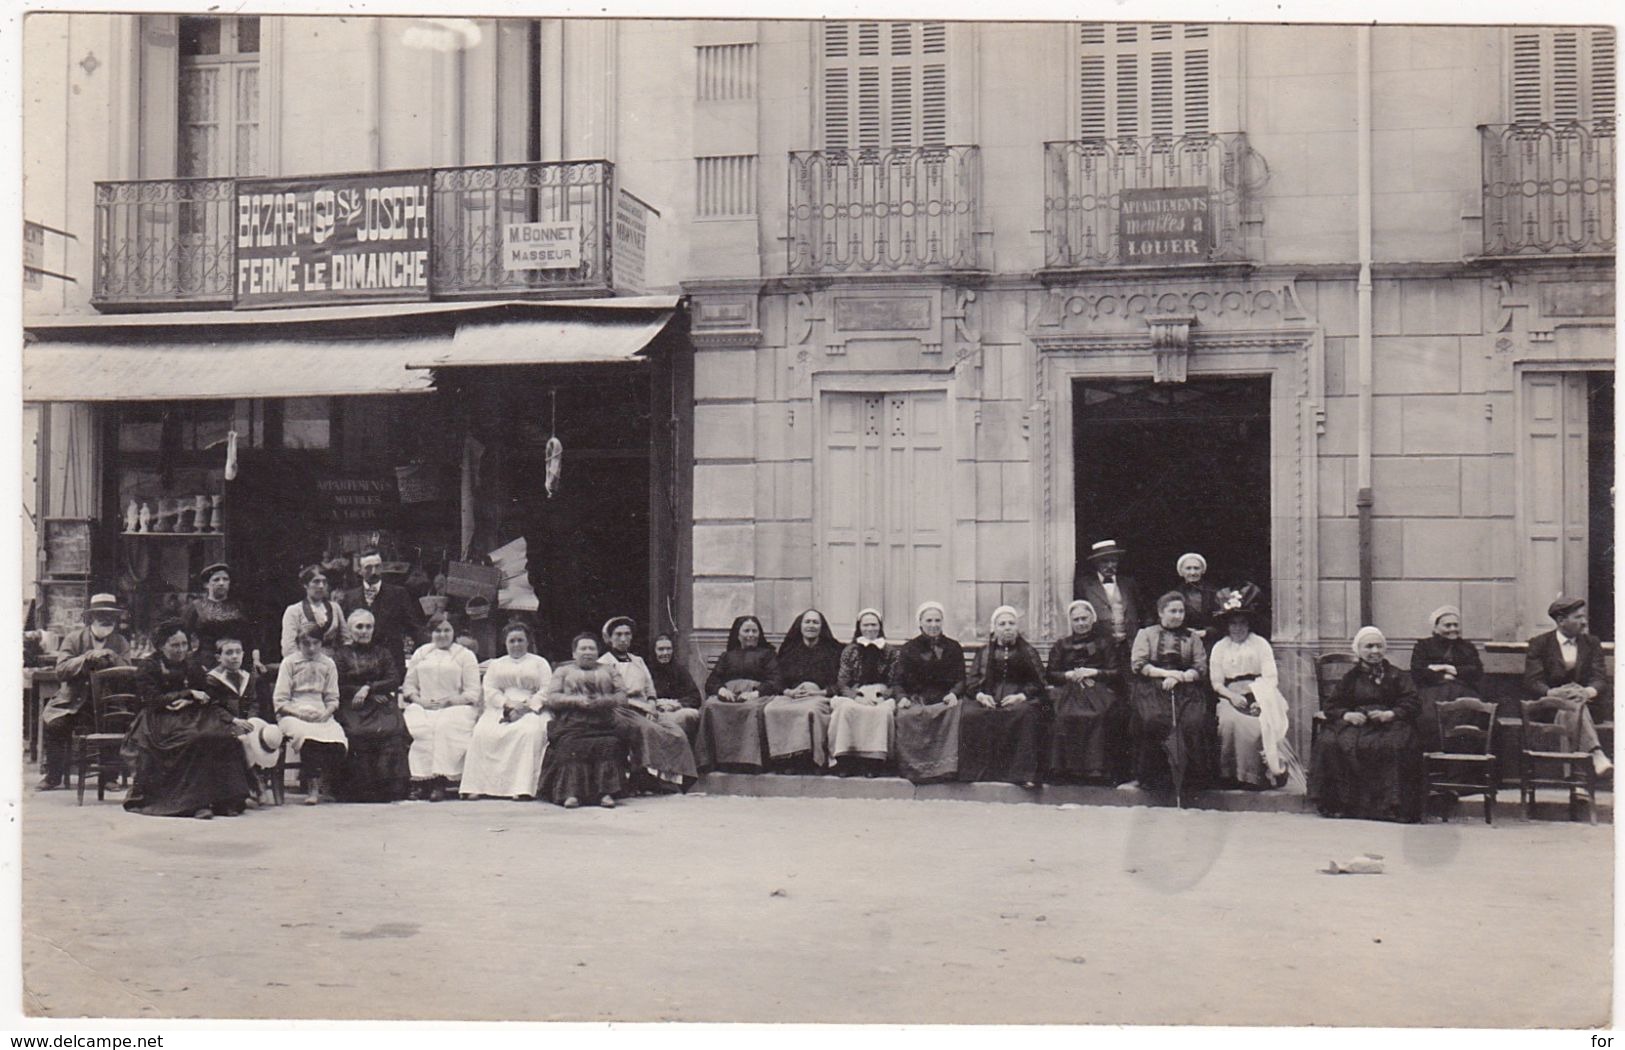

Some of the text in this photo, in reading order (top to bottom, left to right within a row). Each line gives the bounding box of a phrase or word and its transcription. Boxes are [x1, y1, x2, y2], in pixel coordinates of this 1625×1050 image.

[1121, 197, 1208, 214] APPARTEMENTS
[239, 193, 296, 248] BAZAR
[356, 185, 428, 242] JOSEPH
[522, 226, 574, 242] BONNET
[512, 249, 572, 261] MASSEUR
[1128, 238, 1199, 256] LOUER
[238, 251, 428, 294] FERMÉ LE DIMANCHE
